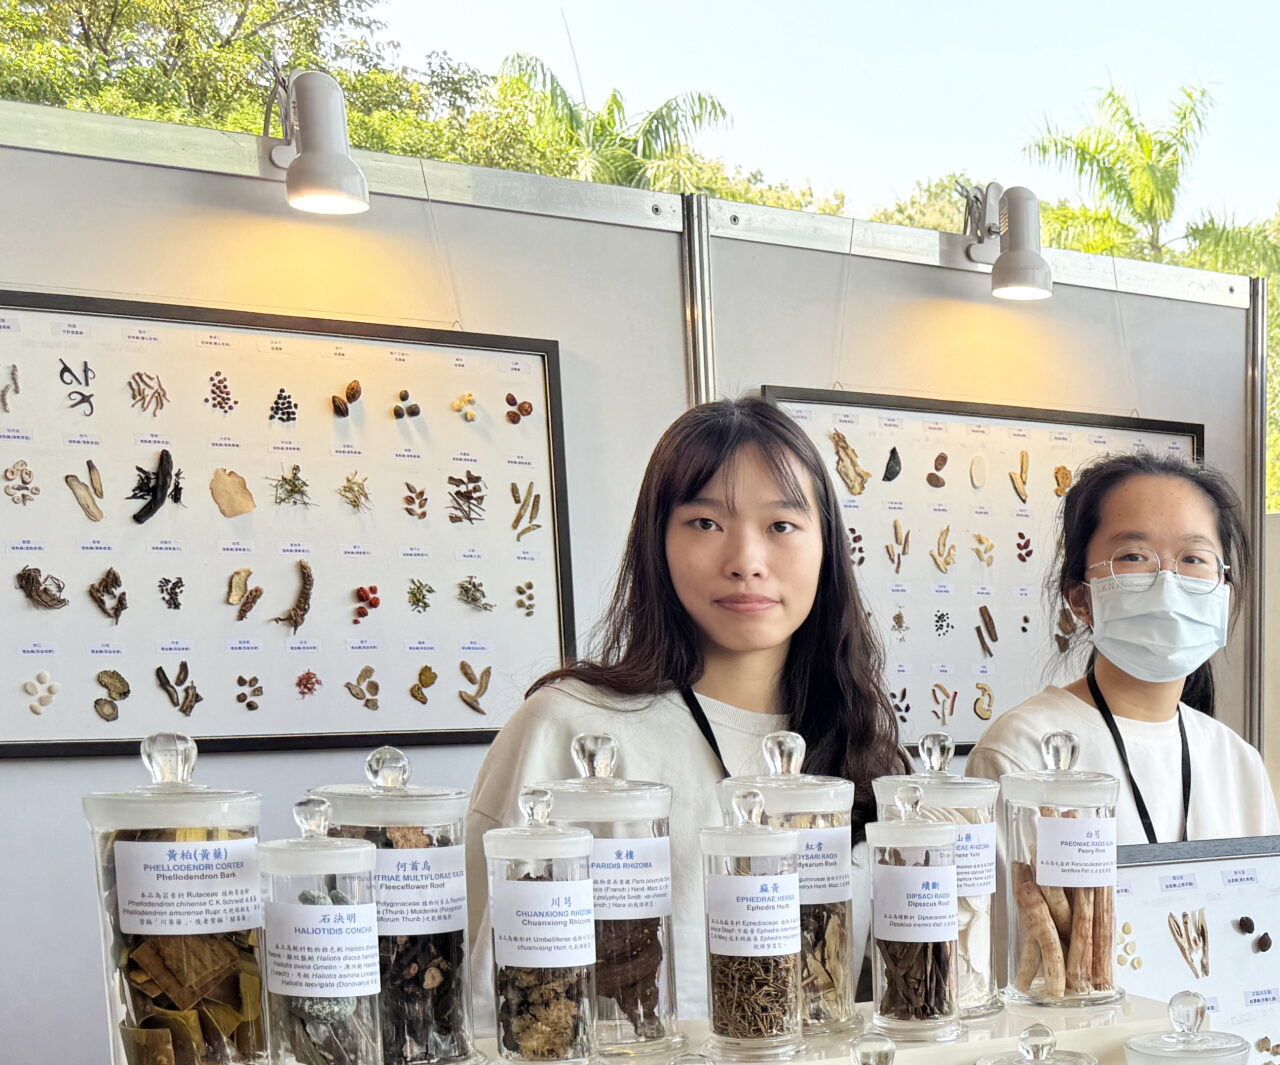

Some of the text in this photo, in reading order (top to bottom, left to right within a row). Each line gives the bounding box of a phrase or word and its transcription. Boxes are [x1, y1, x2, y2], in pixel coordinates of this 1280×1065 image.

[614, 850, 635, 860] 重樓
[396, 861, 431, 871] 何首烏
[403, 872, 451, 881] MULTIFLORAE
[759, 883, 780, 893] 麻黃
[921, 881, 939, 890] 續斷
[516, 910, 569, 918] CHUANXIONG
[522, 919, 567, 927] Chuanxiong
[345, 926, 372, 934] CONCHA
